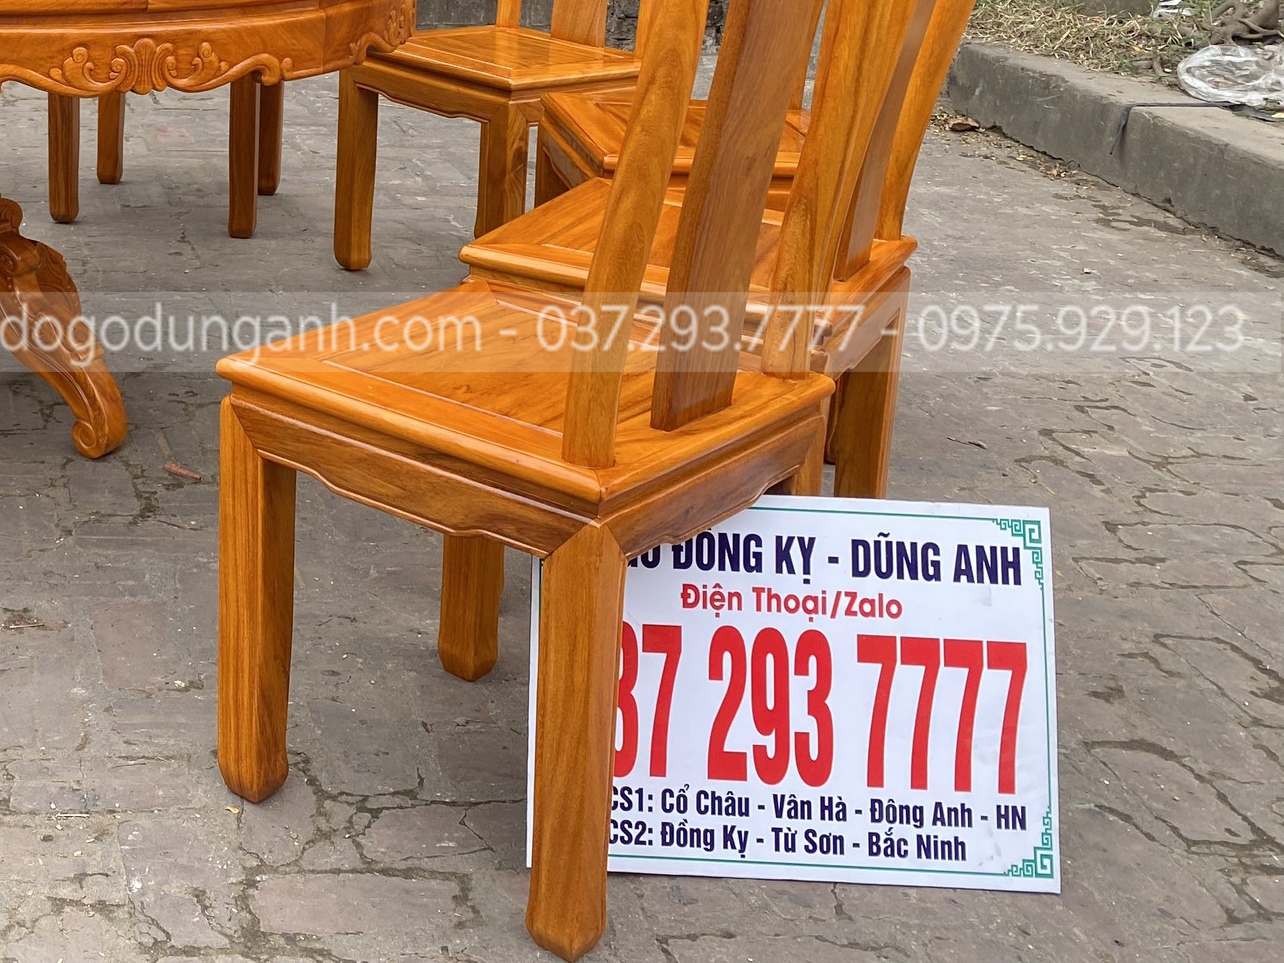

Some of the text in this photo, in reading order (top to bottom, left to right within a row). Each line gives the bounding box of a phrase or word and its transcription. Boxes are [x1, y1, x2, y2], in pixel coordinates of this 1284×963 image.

[776, 536, 815, 584] KỴ
[852, 532, 941, 581] DŨNG
[954, 545, 1021, 585] ANH
[681, 583, 902, 621] Điện Thoại/Zalo
[613, 620, 1027, 793] 37 293 7777
[662, 784, 689, 814] Cổ
[697, 790, 749, 817] Châu
[773, 794, 811, 820] Vân
[820, 796, 846, 821] Hà
[870, 799, 923, 828] Đông
[932, 802, 972, 827] Anh
[997, 805, 1026, 830] HN
[661, 819, 714, 851] Đồng
[723, 825, 748, 858] Kỵ
[772, 827, 797, 852] Từ
[805, 829, 844, 855] Sơn
[868, 832, 908, 858] Bắc
[917, 835, 966, 860] Ninh
